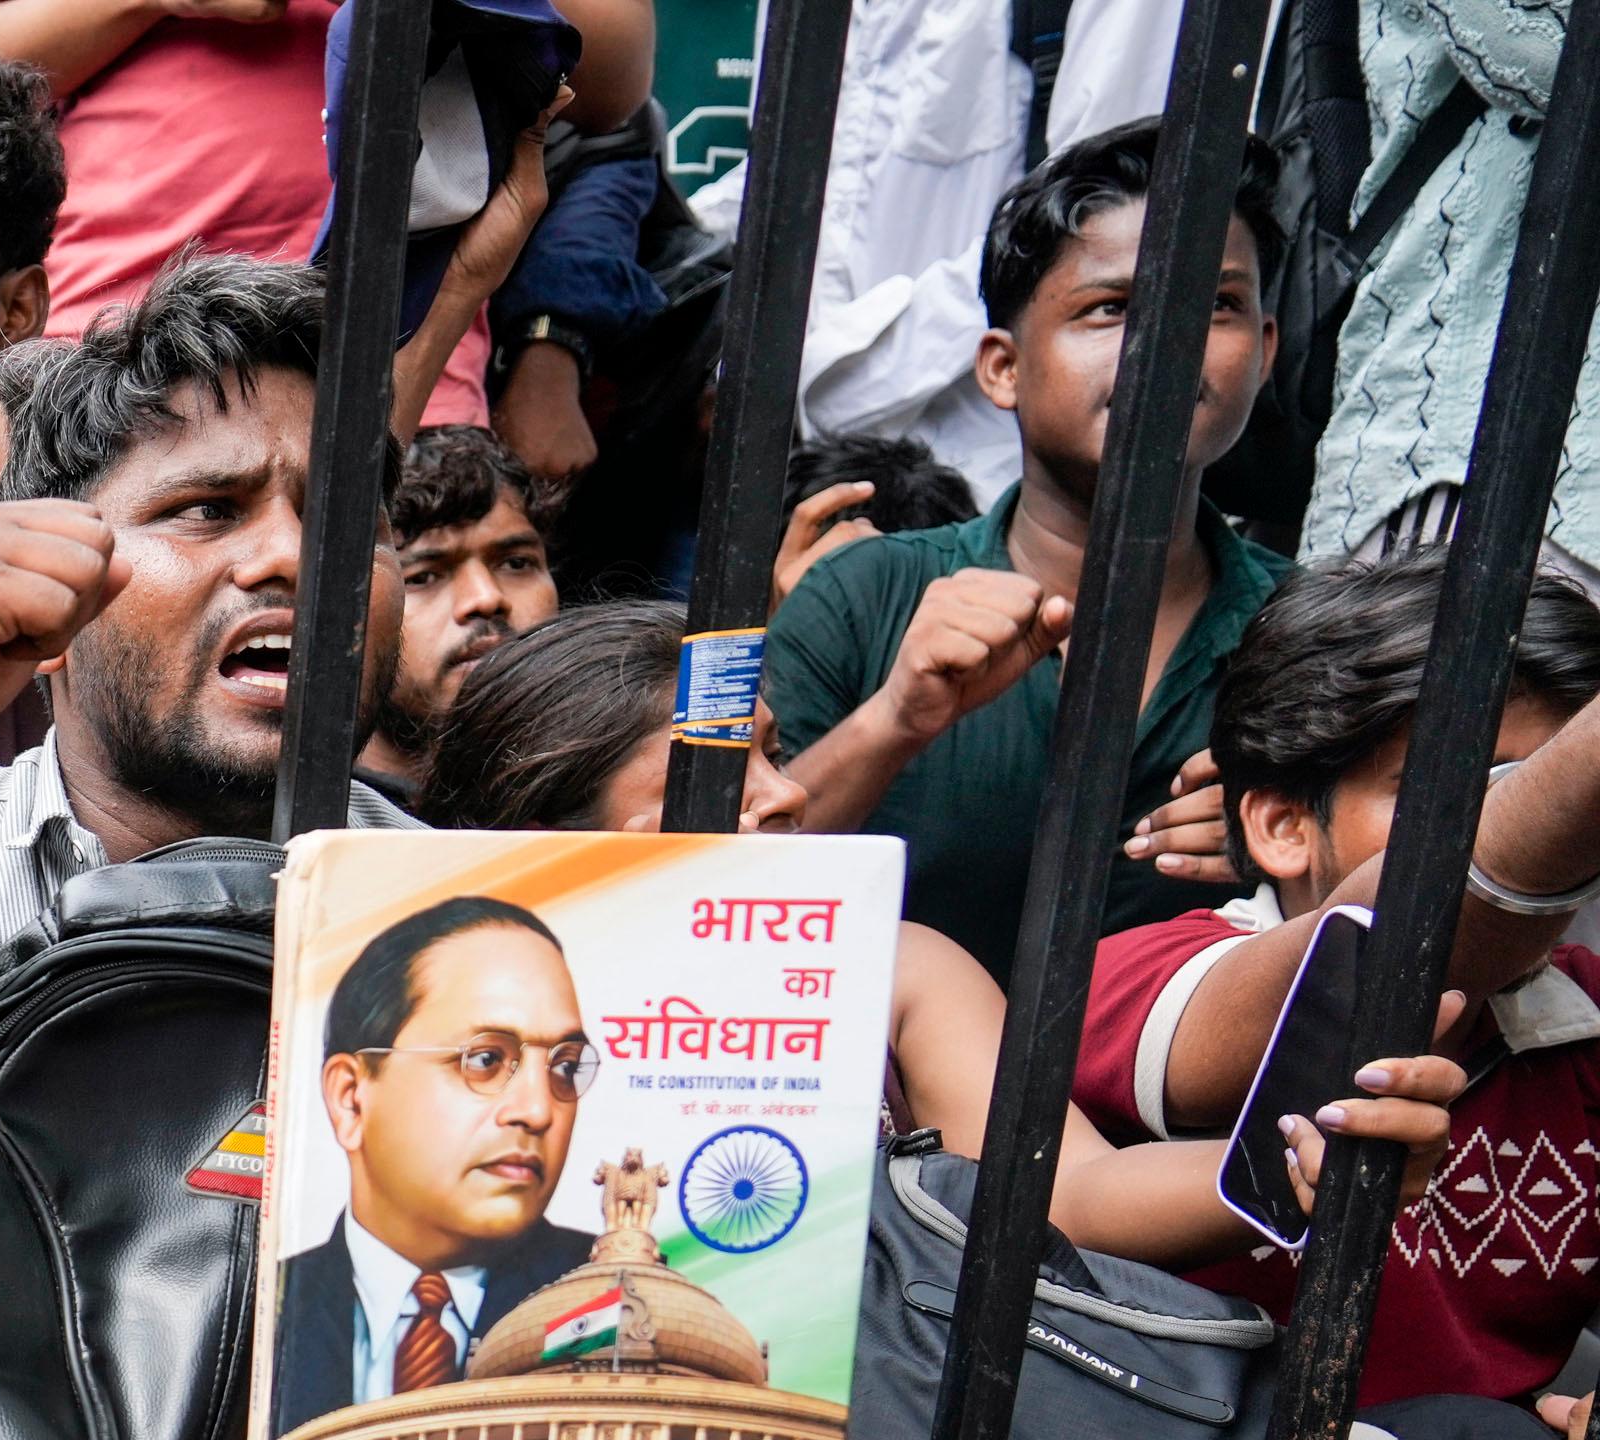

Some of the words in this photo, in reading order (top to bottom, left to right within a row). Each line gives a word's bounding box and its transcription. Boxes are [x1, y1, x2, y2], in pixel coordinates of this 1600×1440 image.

[692, 897, 842, 943] भारत
[782, 968, 836, 998] का
[602, 996, 831, 1061] संविधान
[628, 1074, 654, 1089] THE
[658, 1075, 757, 1090] CONSTITUTION
[761, 1076, 779, 1090] OF
[784, 1076, 822, 1090] INDIA
[215, 1152, 264, 1172] TYCO
